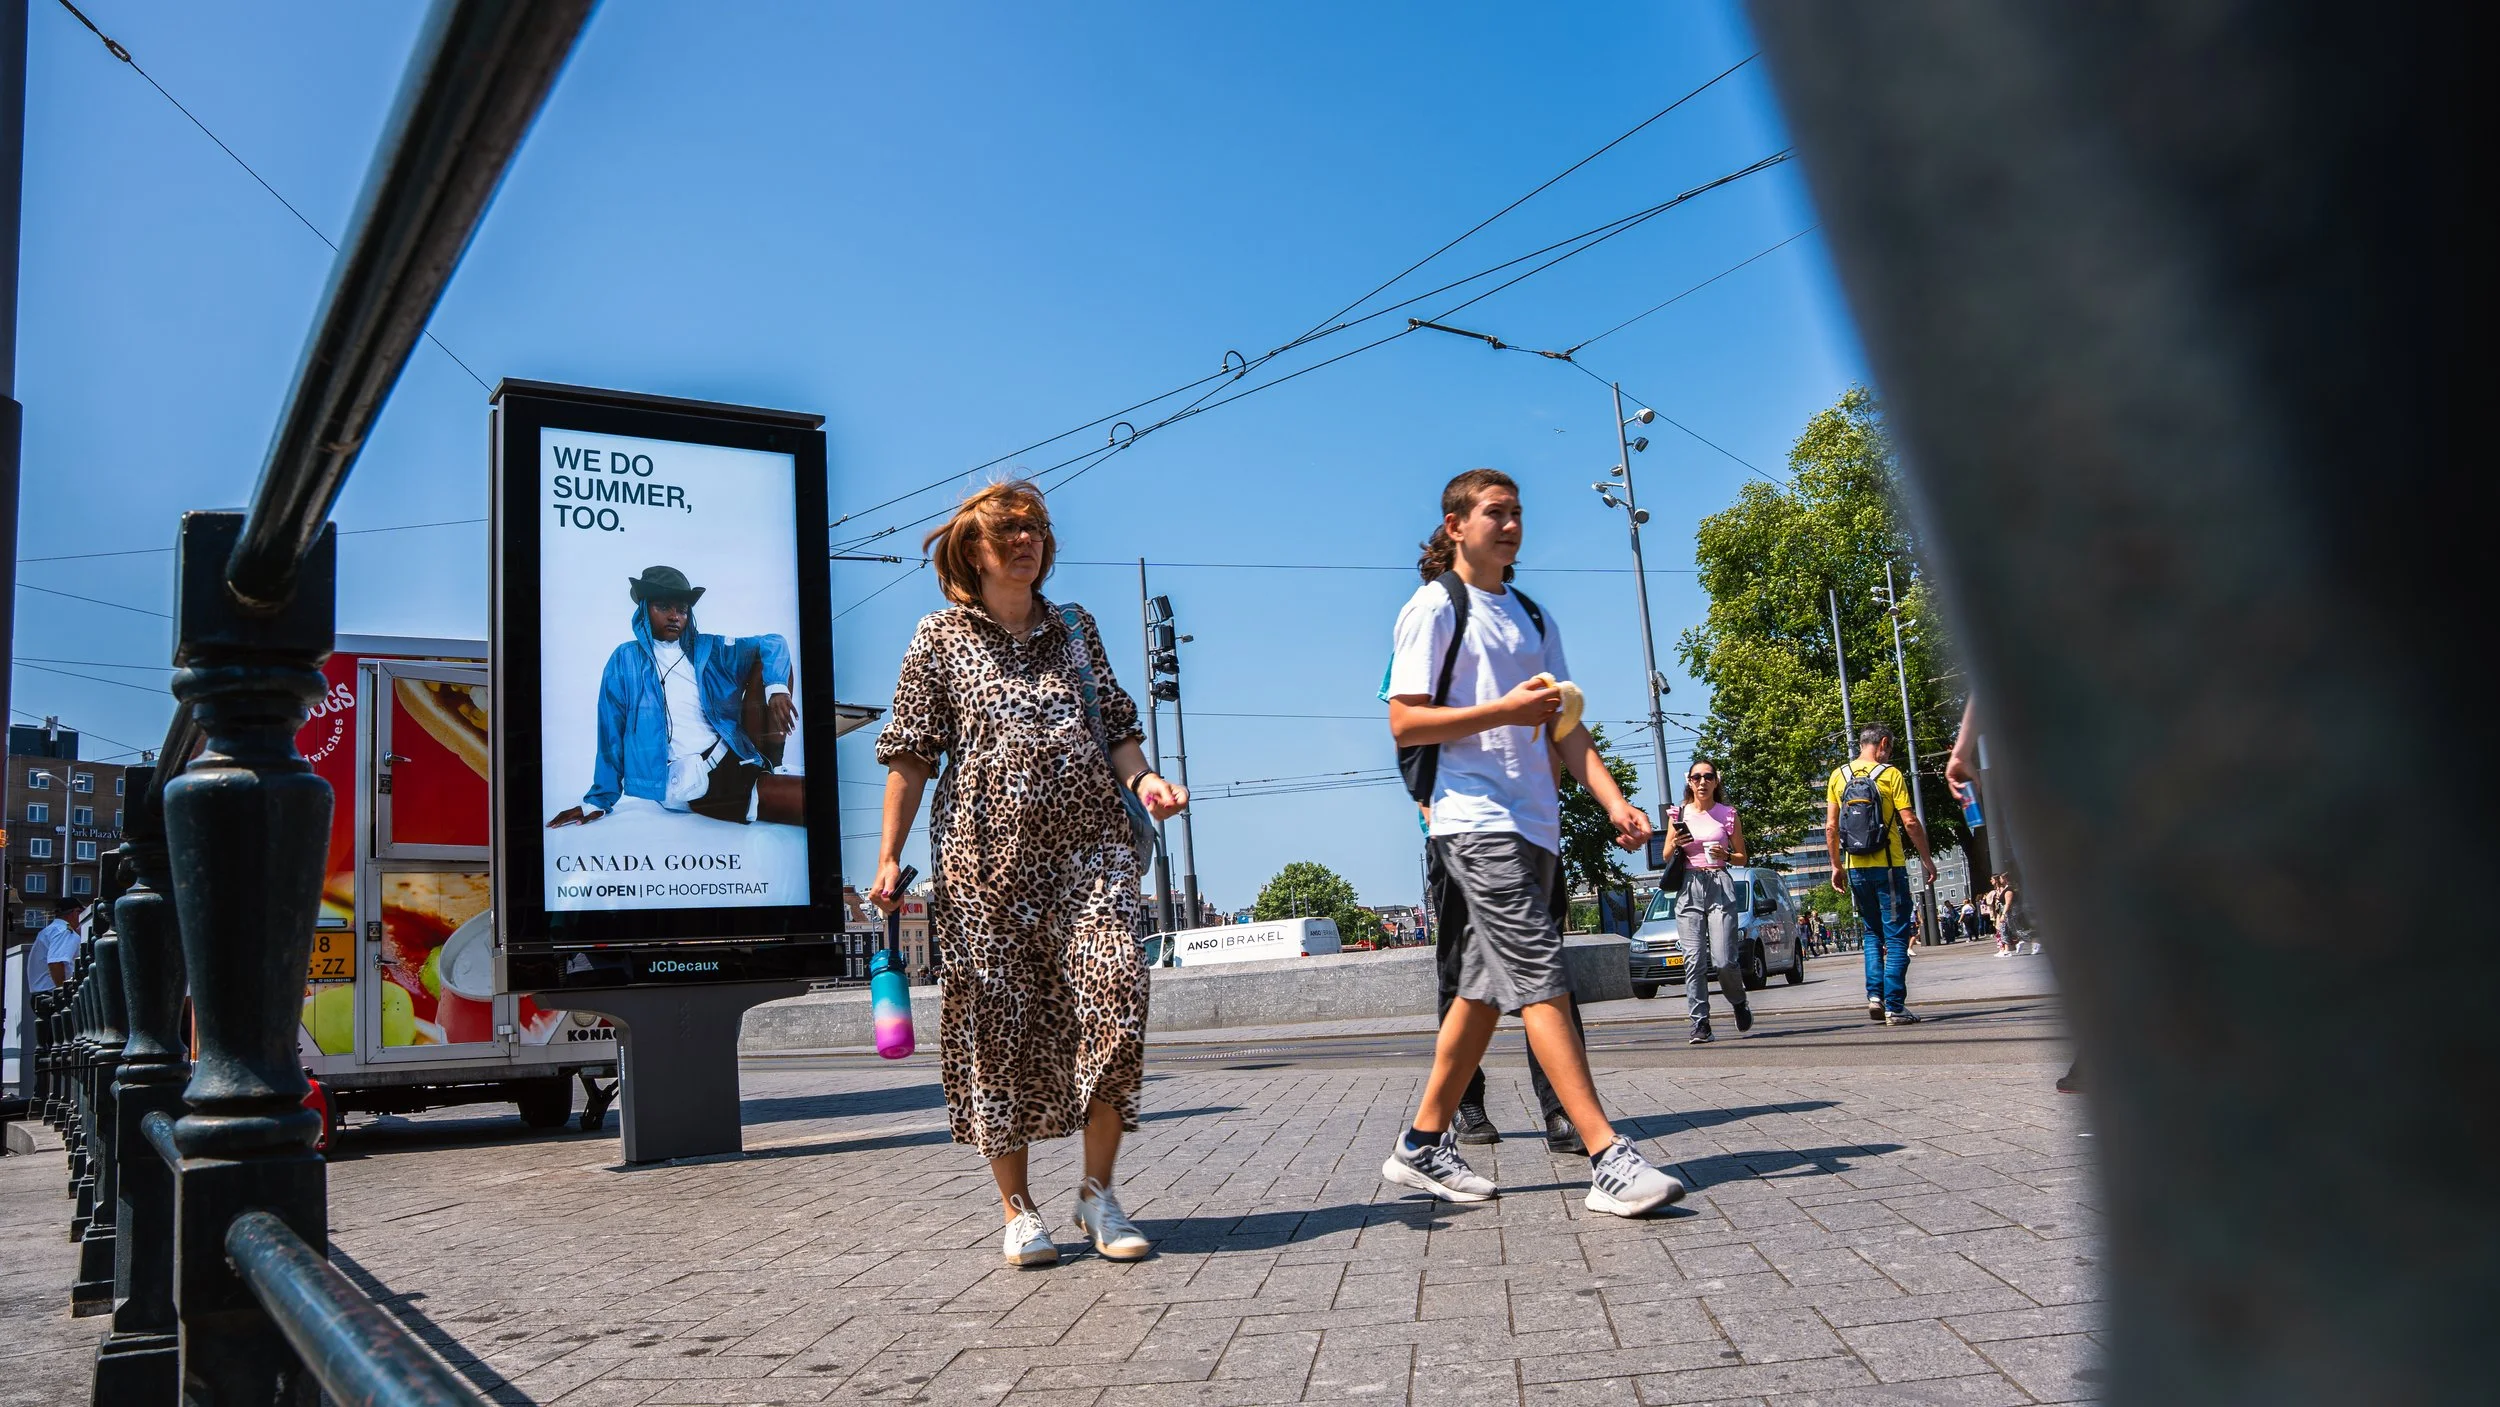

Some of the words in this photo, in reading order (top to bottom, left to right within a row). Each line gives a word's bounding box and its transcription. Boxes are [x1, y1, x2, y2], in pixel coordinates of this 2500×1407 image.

[553, 446, 601, 473] WE
[611, 452, 654, 477] DO
[553, 475, 692, 514] SUMMER,
[553, 504, 625, 532] TOO.
[306, 683, 355, 721] OGS
[556, 855, 655, 873] CANADA
[664, 854, 742, 871] GOOSE
[557, 886, 593, 898] NOW
[596, 885, 636, 897] OPEN
[646, 884, 665, 896] PC
[669, 882, 769, 895] HOOFDSTRAAT
[313, 936, 330, 953] 8
[1187, 939, 1218, 951] ANSO
[1226, 931, 1284, 946] BRAKEL
[648, 960, 719, 973] JCDecaux
